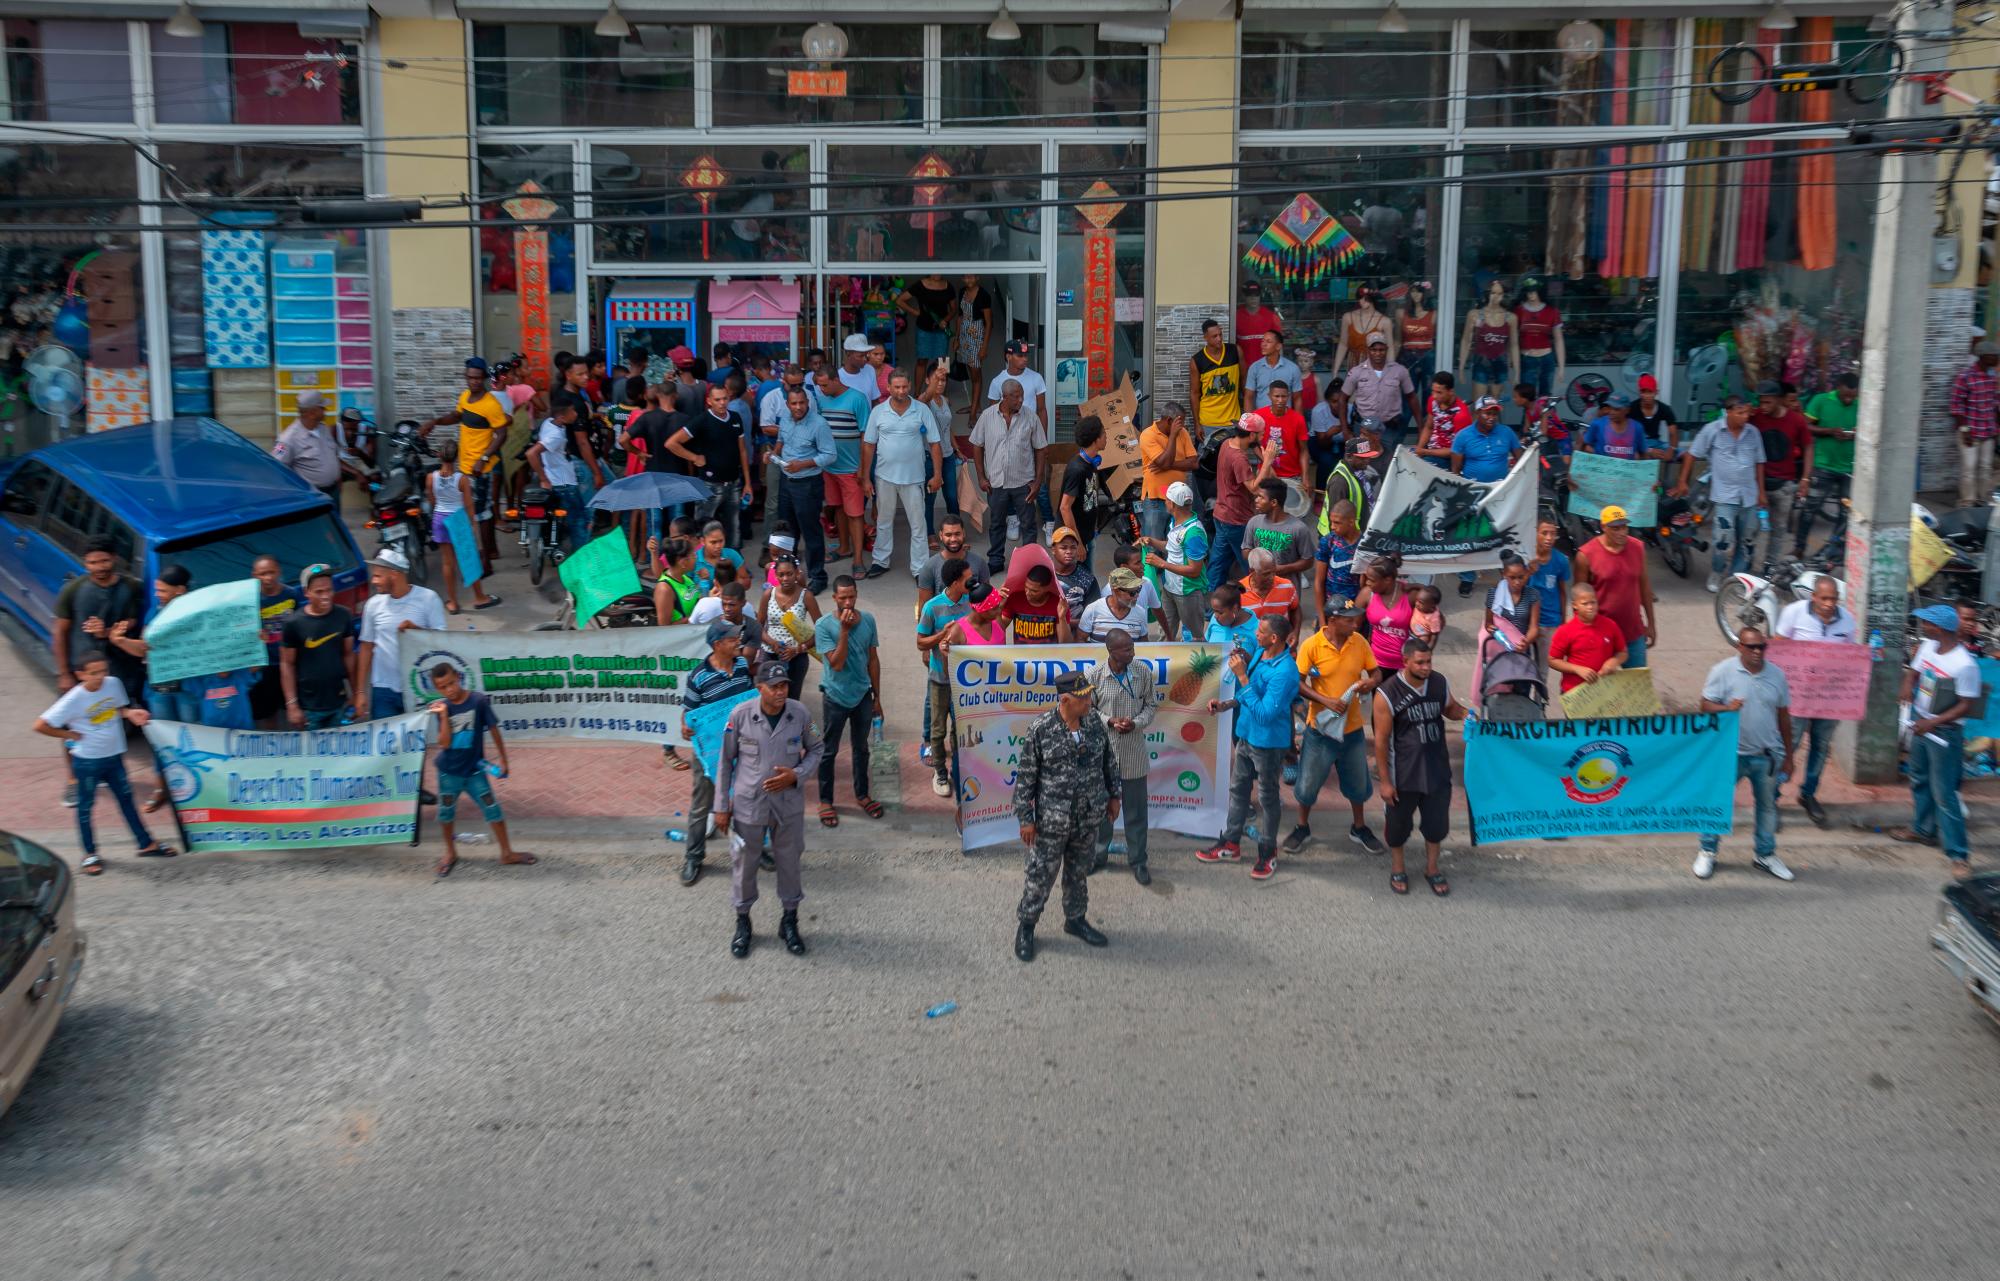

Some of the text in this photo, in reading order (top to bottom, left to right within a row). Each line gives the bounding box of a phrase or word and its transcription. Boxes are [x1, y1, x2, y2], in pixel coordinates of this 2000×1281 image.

[480, 655, 570, 674] Movimiento
[483, 671, 678, 691] Municipio Los Alcarrizos
[554, 692, 574, 704] por
[576, 692, 584, 704] y
[584, 692, 611, 703] para
[613, 691, 625, 702] la
[627, 692, 684, 705] comunida
[959, 690, 1060, 706] Club Cultural Deport
[579, 717, 667, 734] 849-815-8629
[1480, 713, 1719, 740] MARCHA PATRIOTICA
[377, 722, 399, 756] de
[401, 722, 425, 754] los
[228, 769, 305, 805] Derechos
[1491, 810, 1550, 822] PATRIOTA
[1551, 807, 1593, 820] JAMAS
[1597, 806, 1612, 817] SE
[1617, 806, 1659, 817] UNIRA
[1671, 806, 1690, 817] UN
[1692, 806, 1723, 817] PAIS
[276, 827, 313, 841] Los
[318, 822, 416, 839] Alcarrizos
[1548, 821, 1581, 834] PARA
[1584, 819, 1649, 833] HUMILLAR
[1661, 819, 1679, 830] SU
